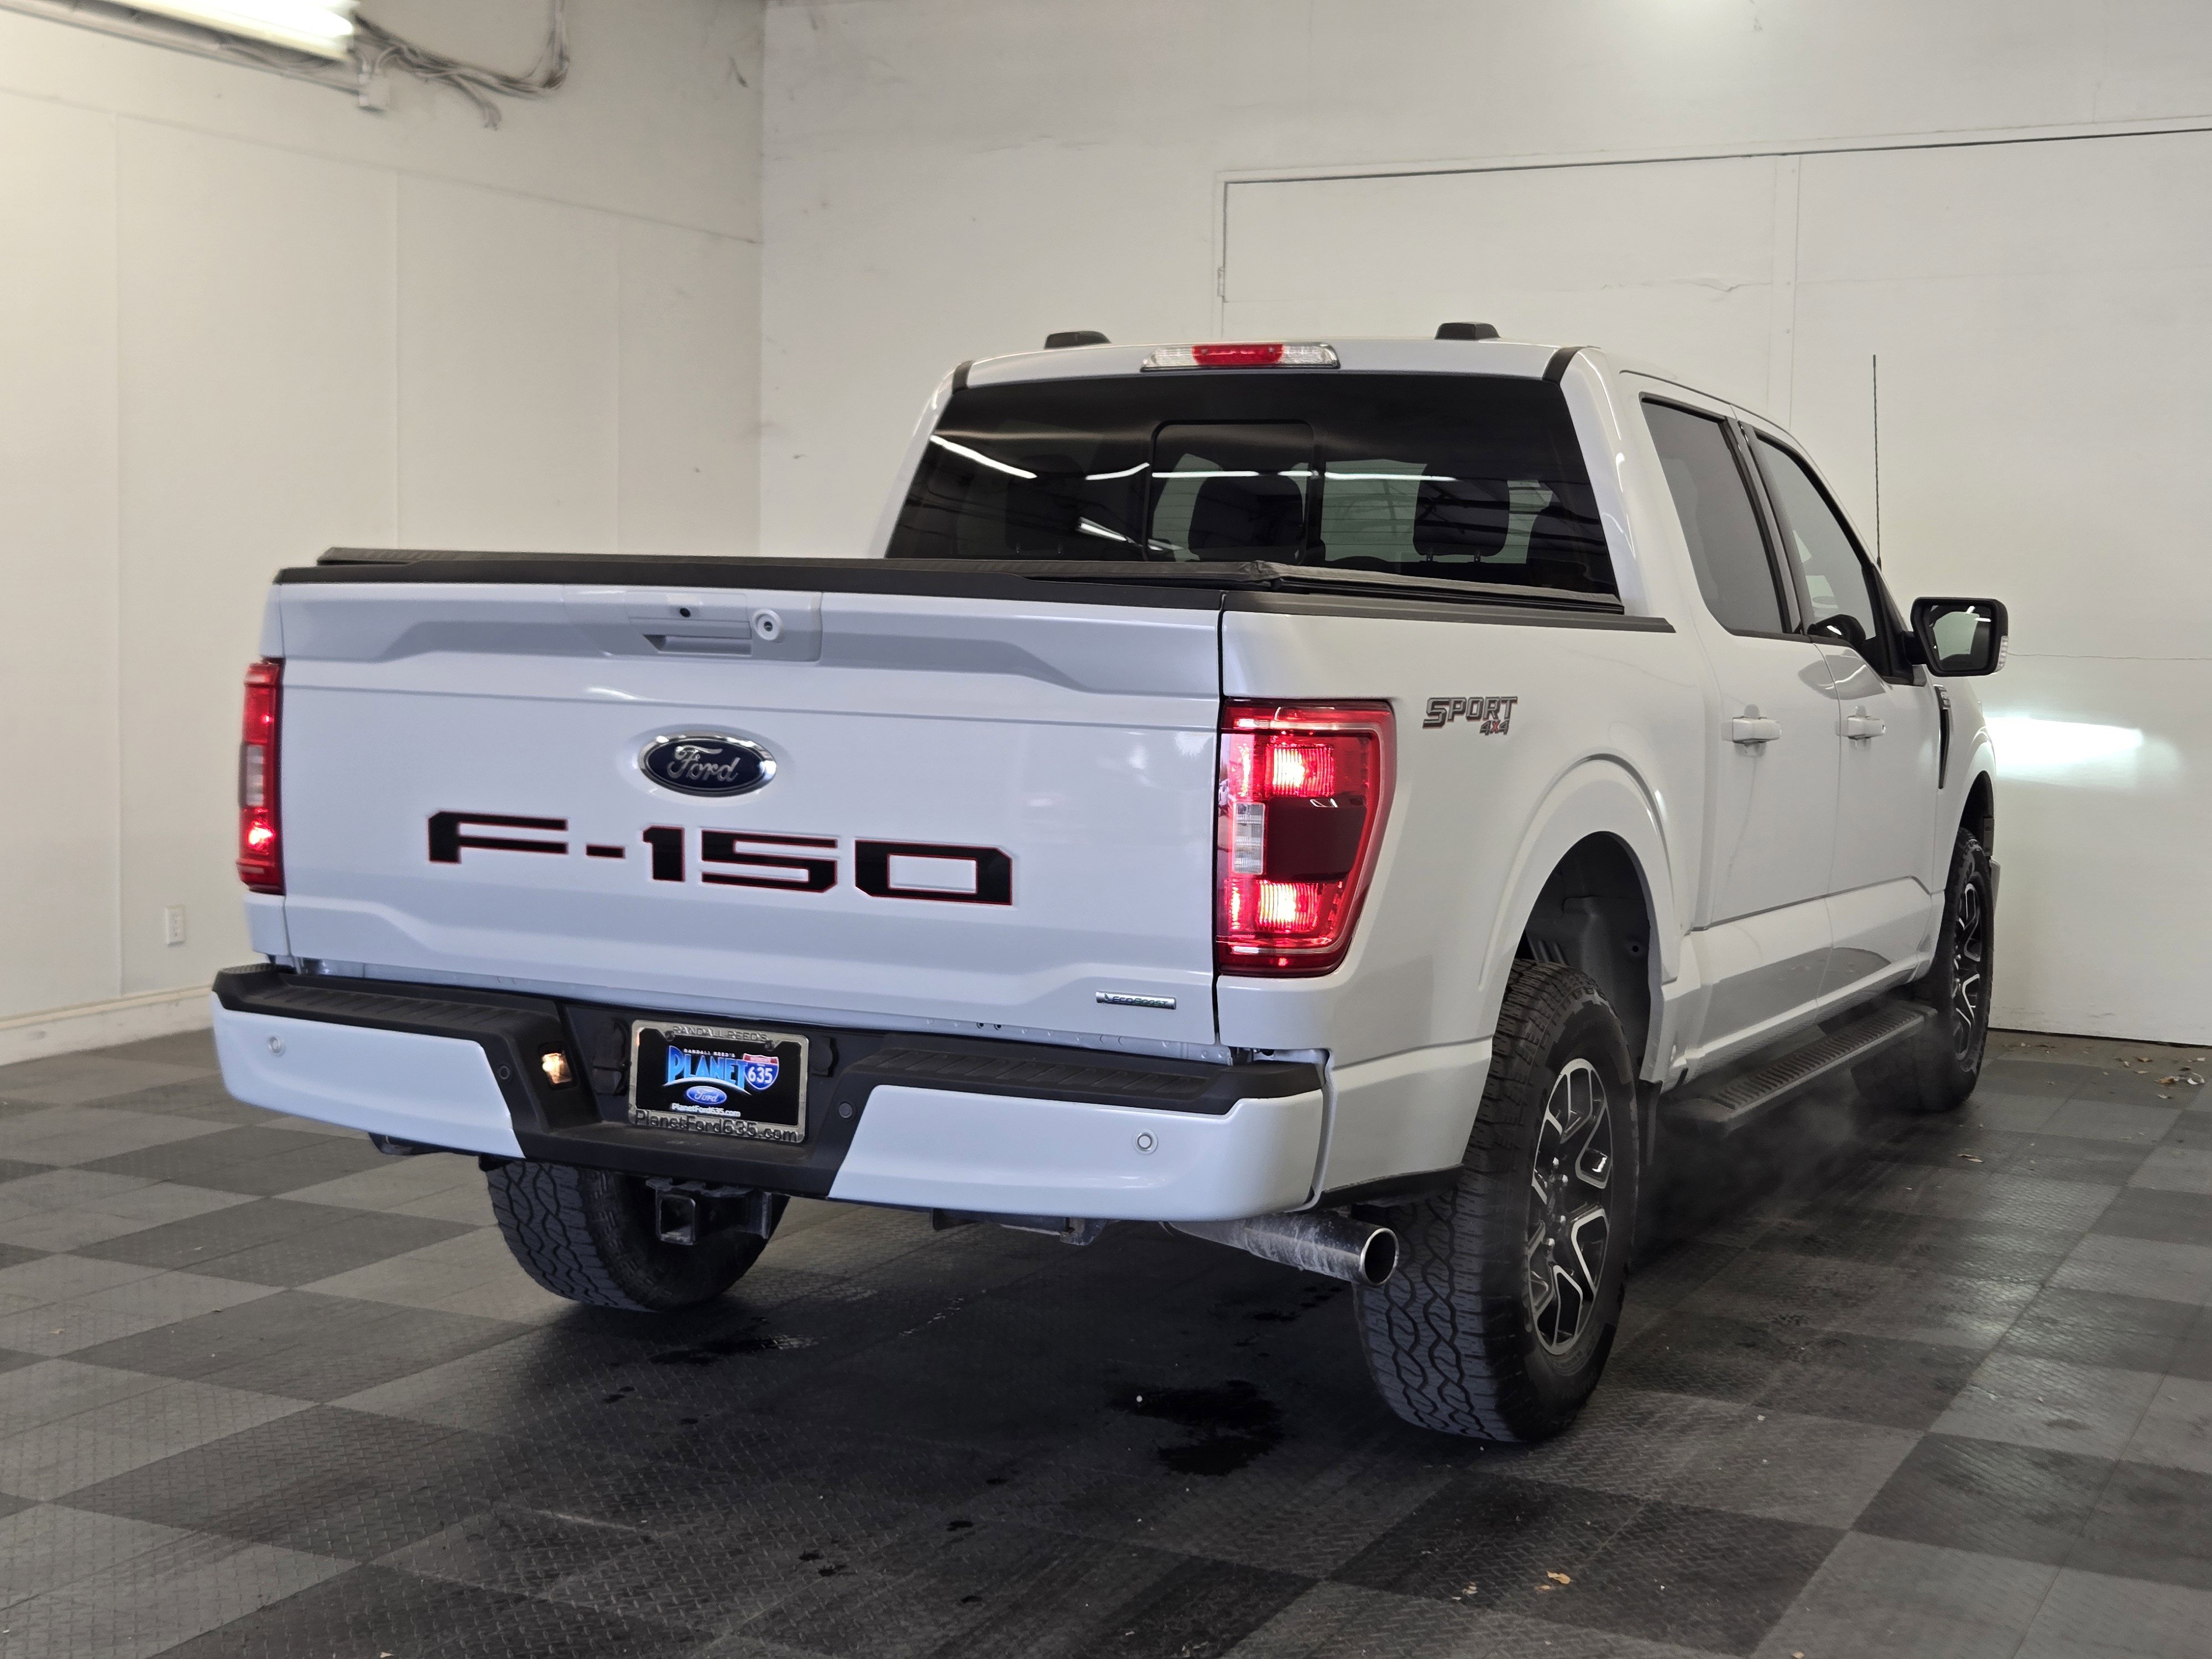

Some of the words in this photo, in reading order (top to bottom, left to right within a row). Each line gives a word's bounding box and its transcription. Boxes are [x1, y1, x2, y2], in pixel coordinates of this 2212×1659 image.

[1422, 696, 1517, 729] SPORT
[666, 744, 741, 782] Ford
[427, 810, 1013, 906] F-150
[672, 1025, 726, 1039] RANDALL
[727, 1031, 769, 1042] REED'S
[748, 1066, 773, 1084] 635
[694, 1088, 718, 1102] Ford
[671, 1102, 741, 1117] PlanetFord635.com
[635, 1109, 799, 1142] PlanetFord635.com
